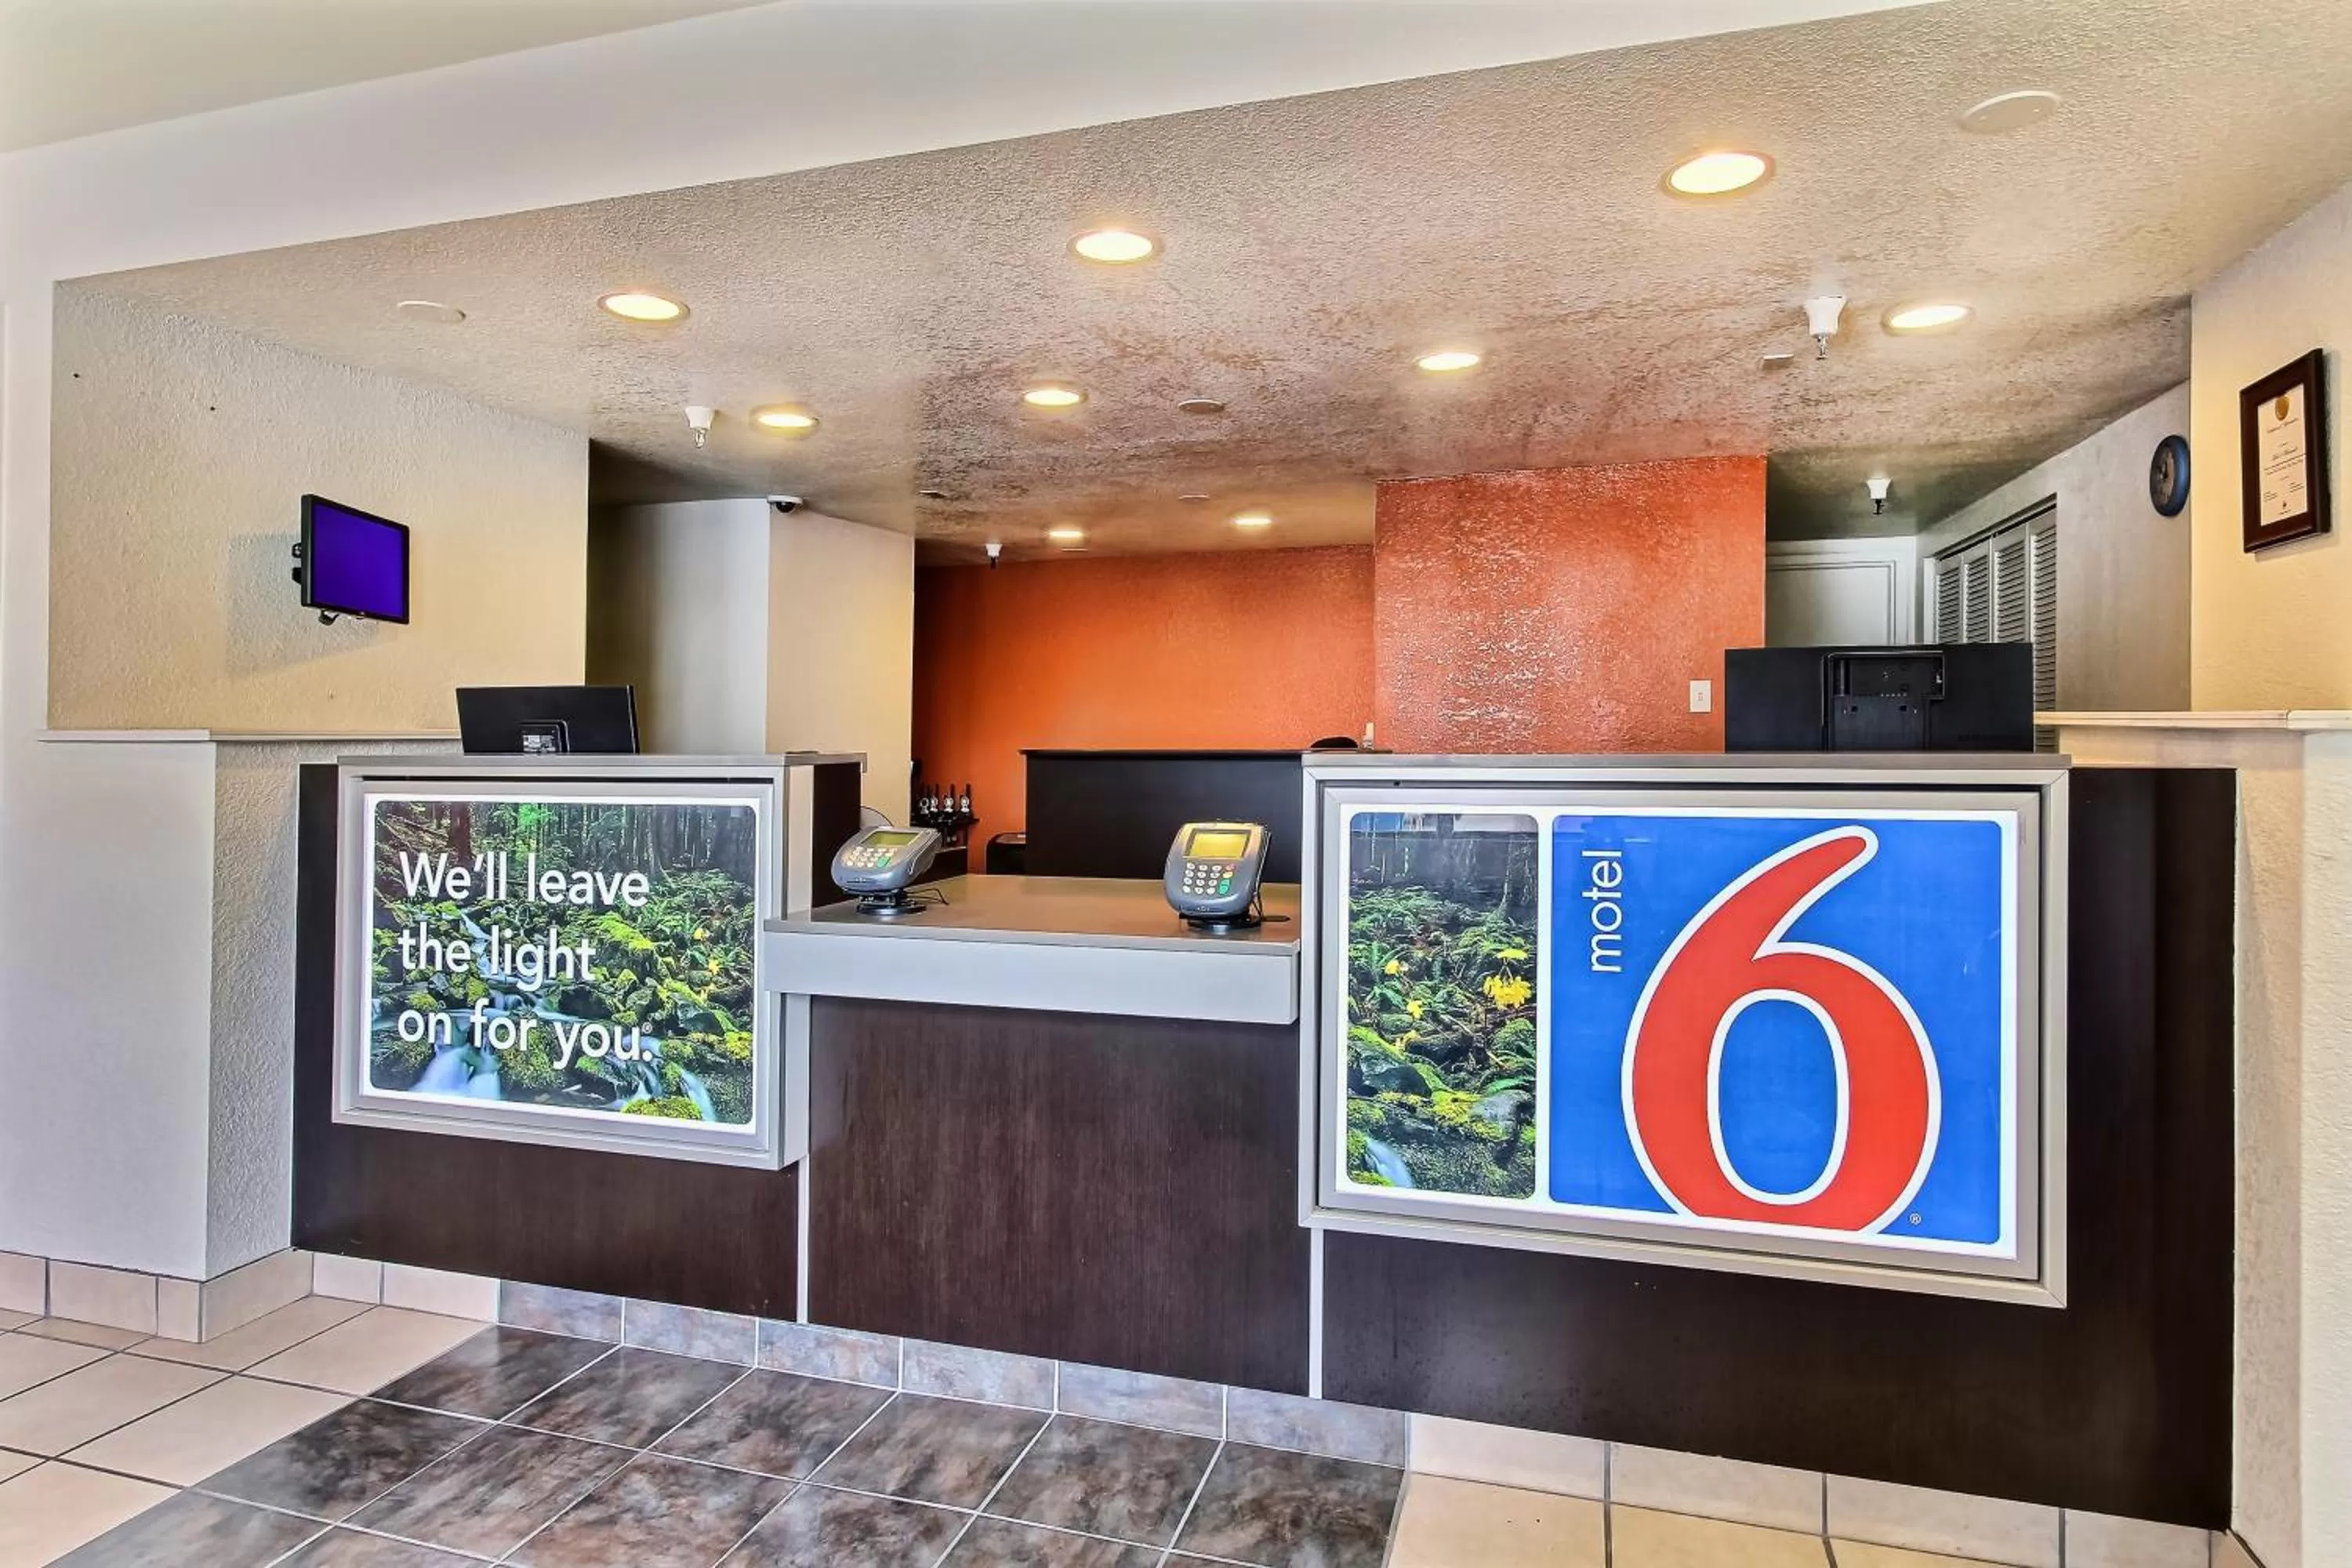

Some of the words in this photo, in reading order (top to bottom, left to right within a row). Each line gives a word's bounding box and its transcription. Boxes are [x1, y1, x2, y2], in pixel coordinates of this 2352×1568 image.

[398, 851, 507, 901] We'll
[528, 853, 650, 907] leave
[397, 922, 471, 973] the
[490, 924, 597, 993] light
[397, 1009, 452, 1045] on
[470, 998, 537, 1052] for
[1582, 849, 1622, 973] motel
[1621, 825, 1942, 1235] 6
